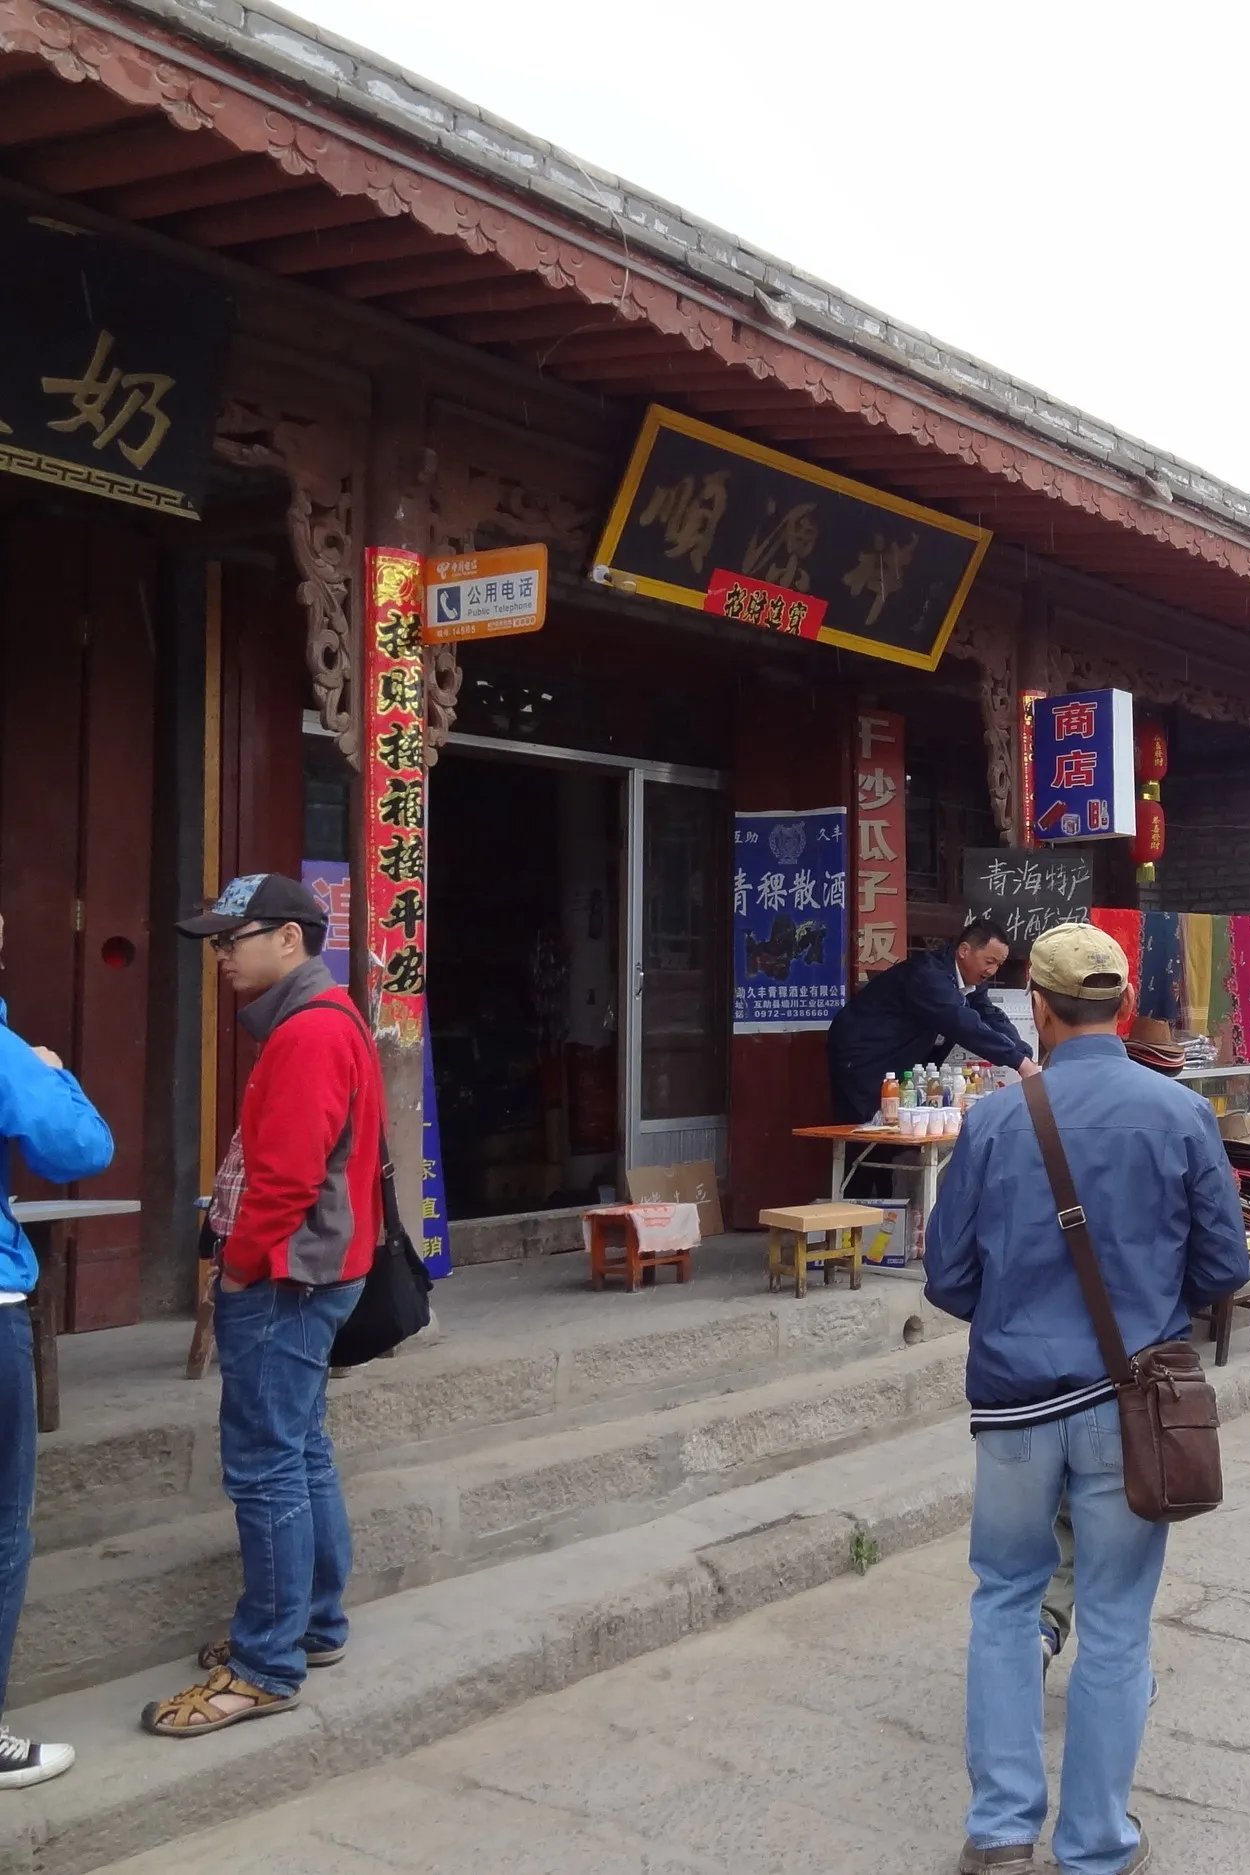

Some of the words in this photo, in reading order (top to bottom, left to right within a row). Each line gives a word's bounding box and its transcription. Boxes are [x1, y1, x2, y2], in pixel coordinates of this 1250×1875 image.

[467, 577, 533, 605] 公用电话
[467, 608, 490, 617] Public
[494, 602, 532, 614] Telephone
[1051, 701, 1098, 789] 商店
[817, 824, 844, 843] 久丰
[733, 867, 846, 917] 青稞散酒
[980, 858, 1091, 901] 青海特产
